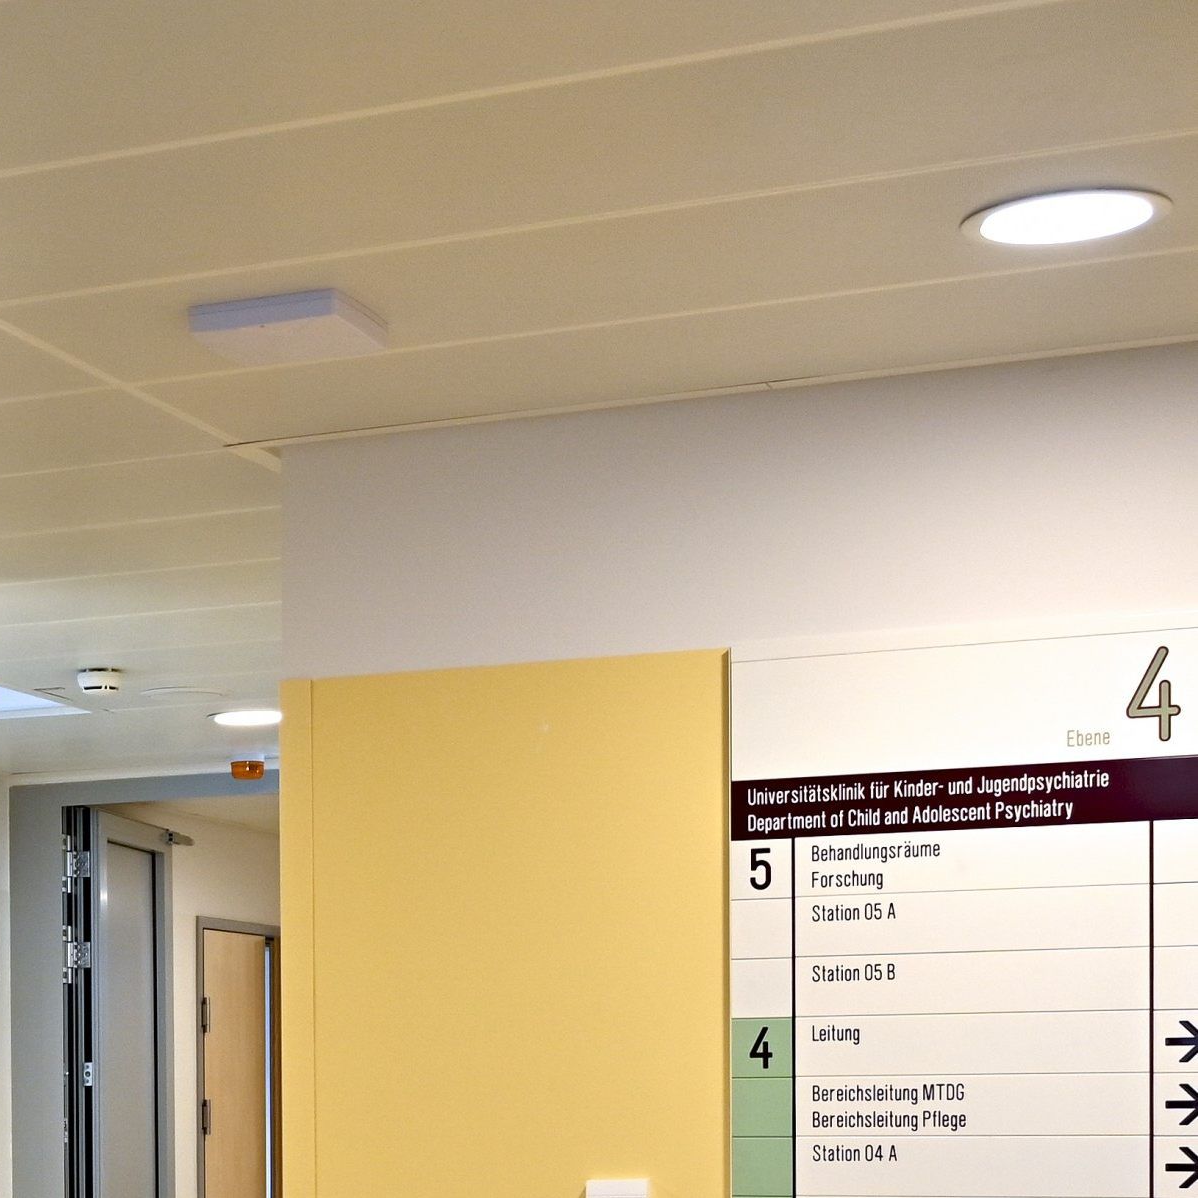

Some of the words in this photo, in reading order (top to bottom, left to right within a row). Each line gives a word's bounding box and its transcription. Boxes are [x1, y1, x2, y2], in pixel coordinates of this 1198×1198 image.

[1125, 645, 1182, 742] 4
[1066, 729, 1111, 748] Ebene
[747, 782, 866, 806] Universitätsklinik
[869, 781, 890, 800] für
[893, 779, 944, 798] Kinder-
[948, 776, 973, 796] und
[976, 769, 1110, 798] Jugendpsychiatrie
[747, 810, 827, 835] Department
[830, 809, 844, 828] of
[847, 807, 881, 827] Child
[884, 806, 909, 826] and
[912, 801, 992, 823] Adolescent
[995, 798, 1074, 823] Psychiatry
[811, 840, 941, 864] Behandlungsräume
[749, 847, 772, 891] 5
[811, 869, 884, 890] Forschung
[811, 904, 860, 923] Station
[864, 902, 883, 921] 05
[887, 902, 896, 920] A
[811, 964, 860, 983] Station
[864, 963, 883, 981] 05
[887, 963, 896, 981] B
[812, 1024, 860, 1046] Leitung
[749, 1026, 773, 1070] 4
[812, 1084, 918, 1106] Bereichsleitung
[922, 1083, 965, 1101] MTDG
[812, 1110, 919, 1132] Bereichsleitung
[922, 1110, 967, 1132] Pflege
[812, 1144, 861, 1162] Station
[864, 1144, 884, 1162] 04
[888, 1144, 898, 1162] A
